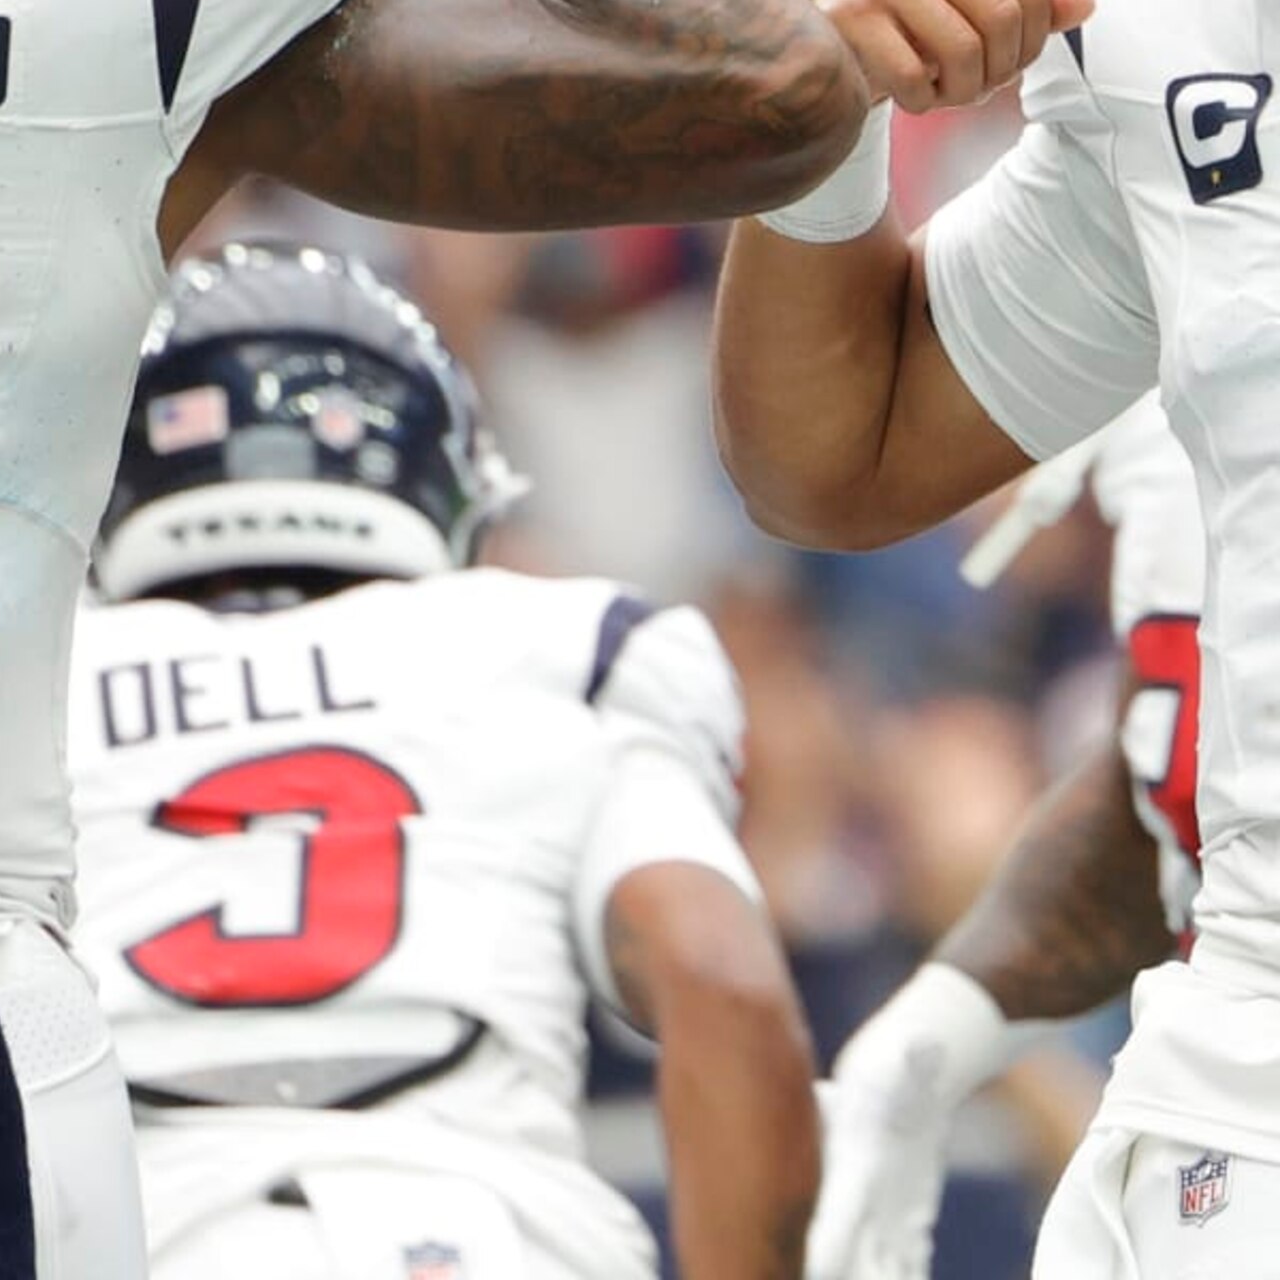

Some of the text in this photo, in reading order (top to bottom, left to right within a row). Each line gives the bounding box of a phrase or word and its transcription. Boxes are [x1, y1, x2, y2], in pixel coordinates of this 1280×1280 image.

[1172, 80, 1259, 168] C
[98, 644, 377, 750] DELL
[123, 743, 423, 1009] 3
[1183, 1181, 1223, 1213] NFL
